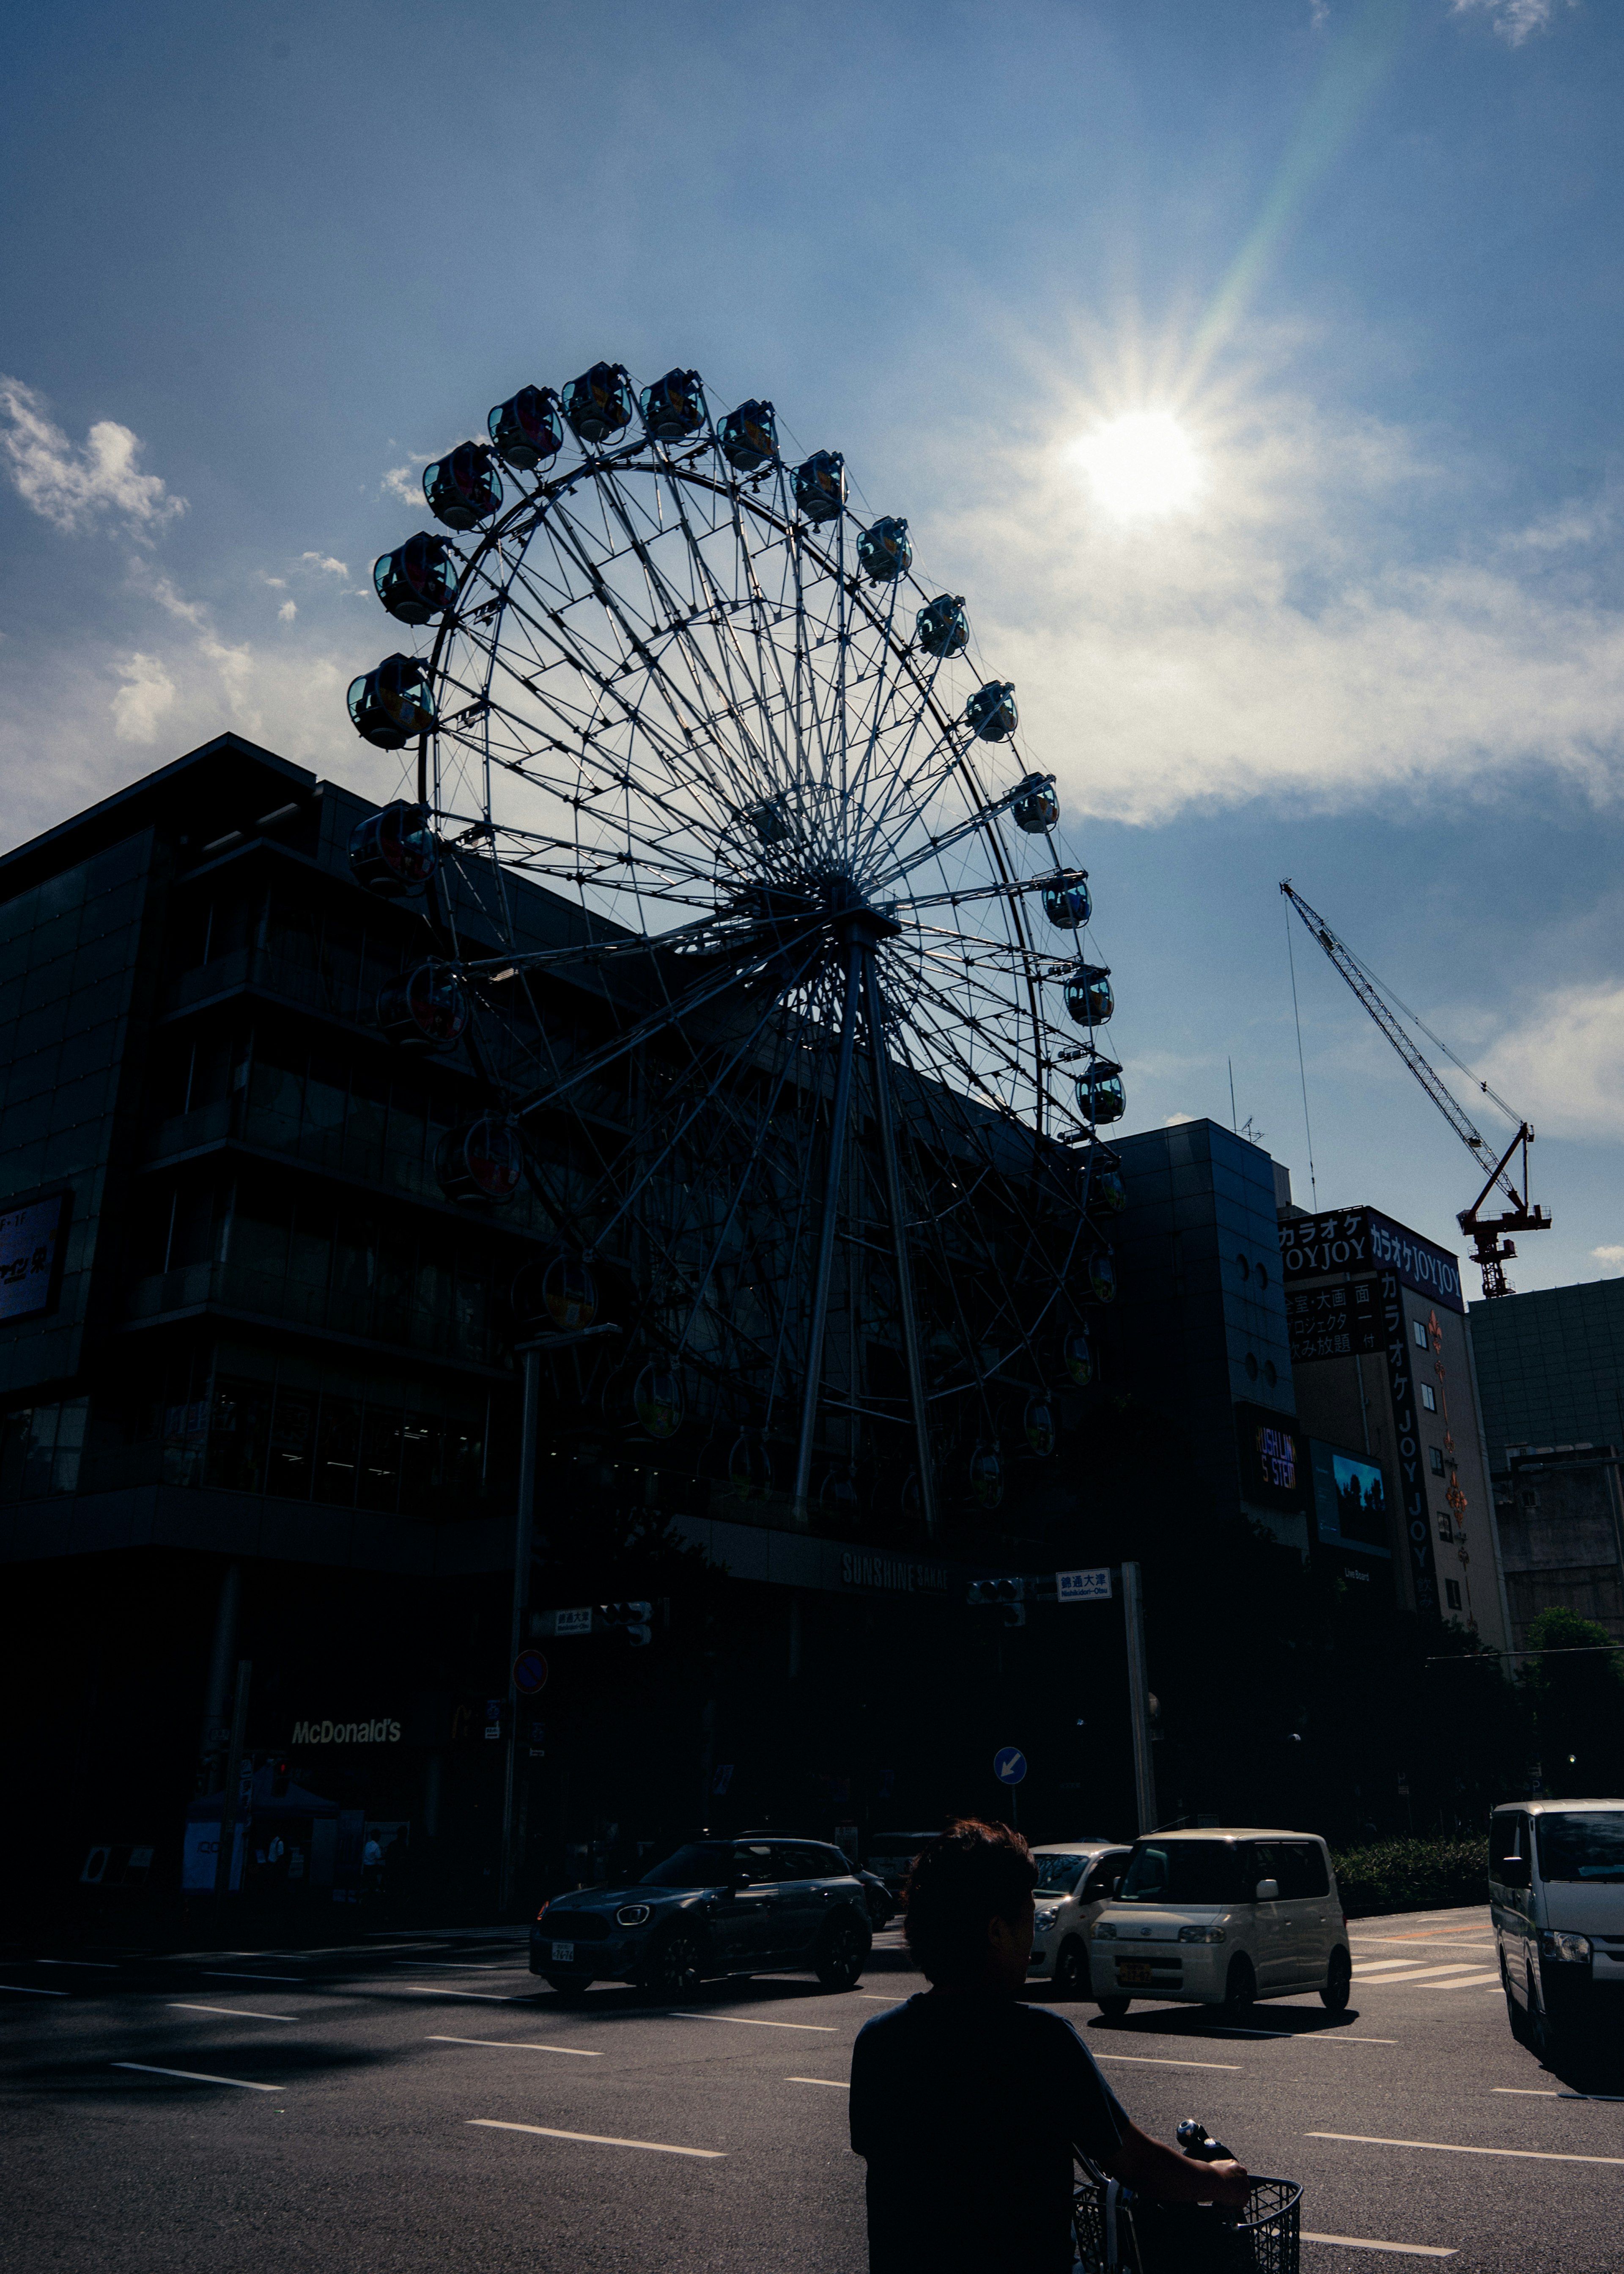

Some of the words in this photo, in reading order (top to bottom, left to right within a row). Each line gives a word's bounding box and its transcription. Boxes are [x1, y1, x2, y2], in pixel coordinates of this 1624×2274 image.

[1278, 1215, 1361, 1247] カラオケ
[1281, 1236, 1365, 1270] OYJOY
[1381, 1272, 1408, 1401] カラオケ
[1261, 1454, 1296, 1489] SSTEM
[843, 1552, 914, 1592] SUNSHINE
[917, 1564, 947, 1589] SAKAE
[1061, 1573, 1106, 1588] 錦通大津
[292, 1718, 401, 1744] McDonald's
[1532, 1780, 1540, 1792] P
